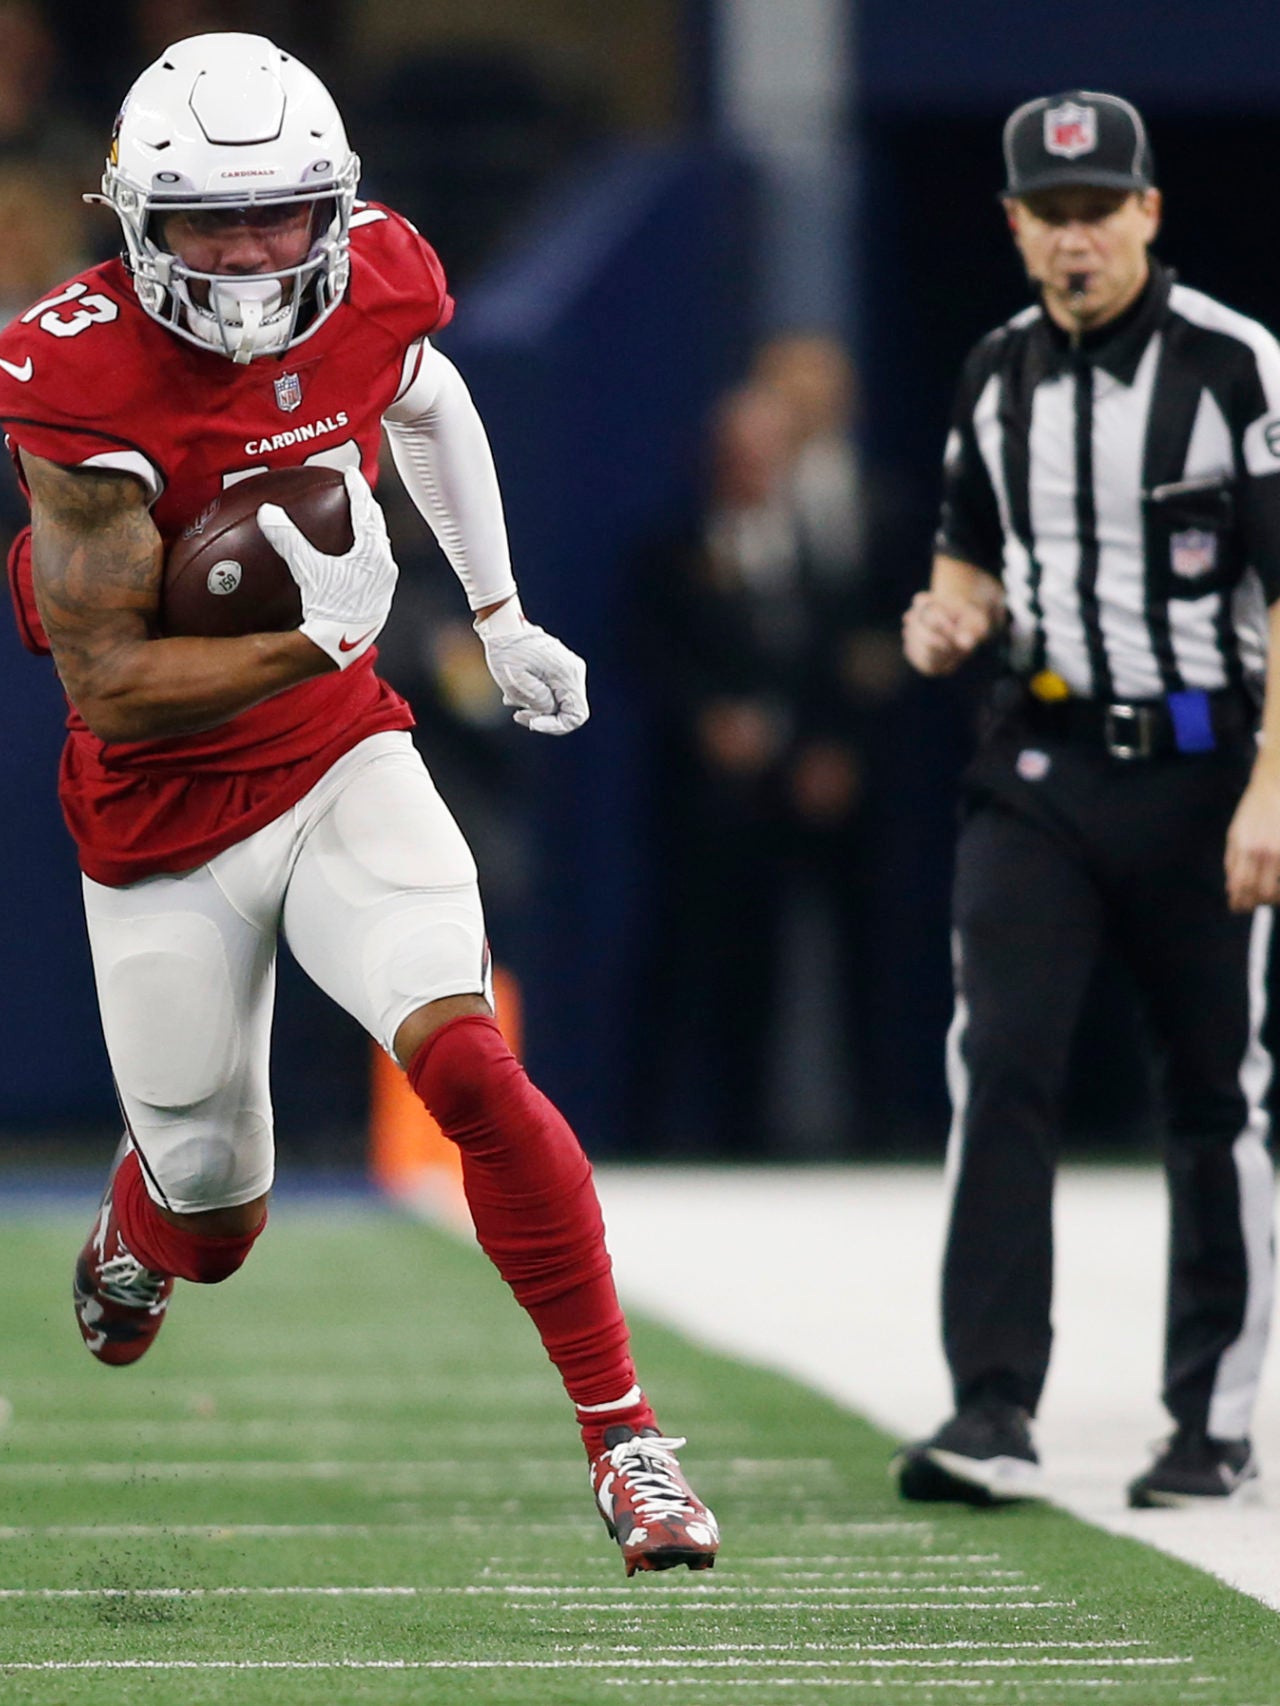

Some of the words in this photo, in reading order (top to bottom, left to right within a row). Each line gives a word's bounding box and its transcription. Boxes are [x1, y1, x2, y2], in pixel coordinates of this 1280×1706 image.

[220, 169, 276, 179] CARDINALS
[19, 281, 119, 338] 13
[244, 411, 350, 456] CARDINALS
[218, 572, 238, 592] 159
